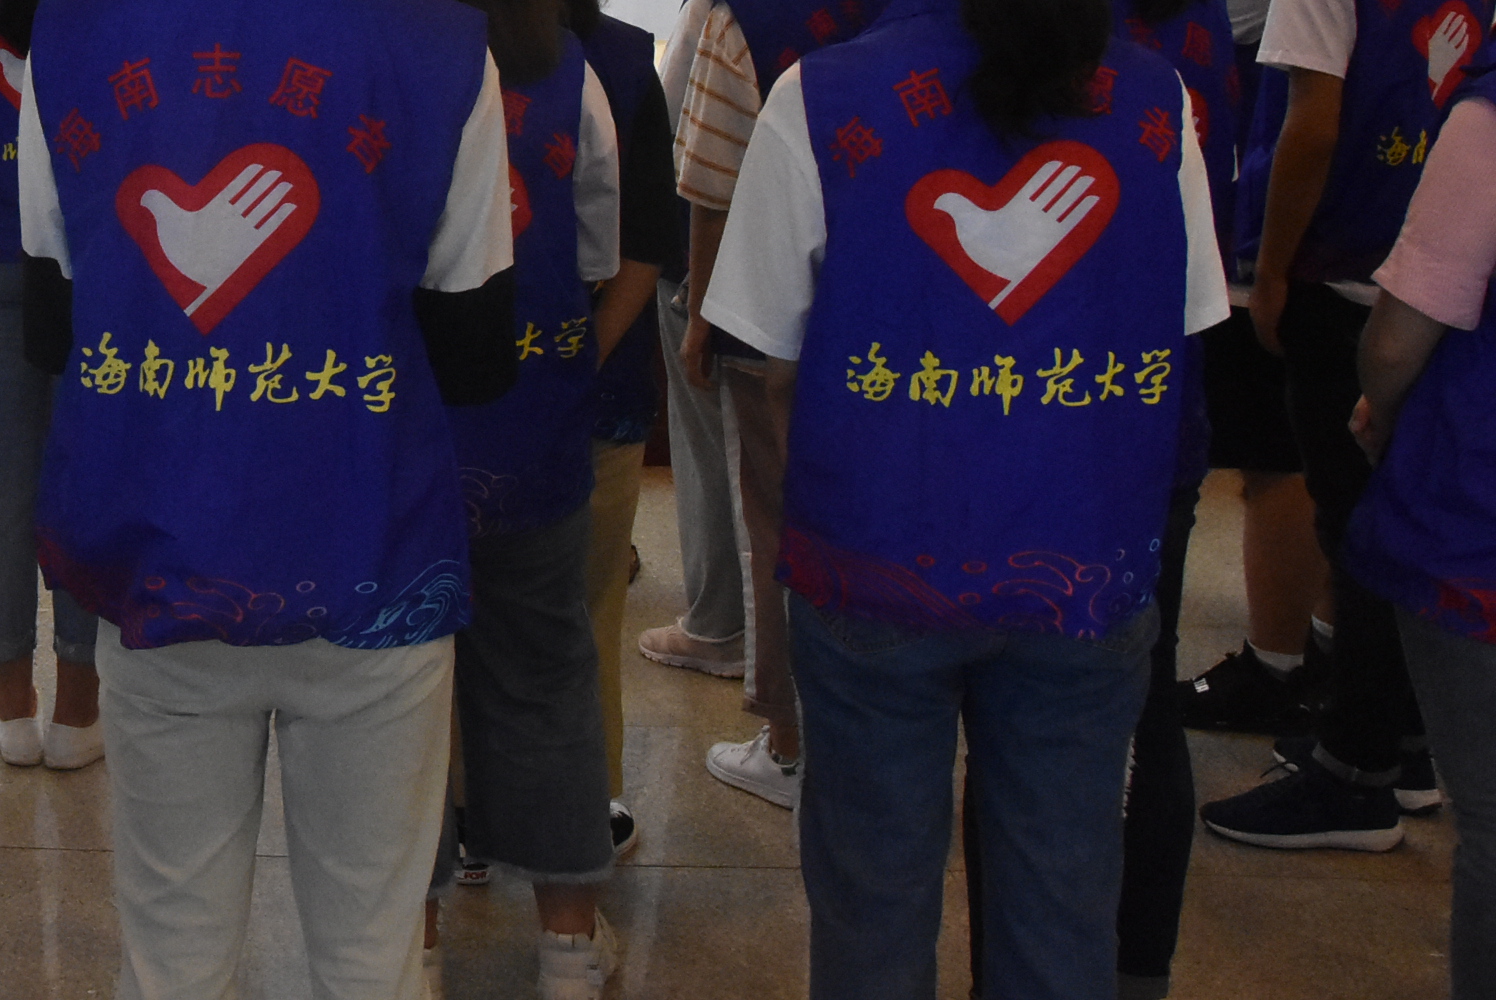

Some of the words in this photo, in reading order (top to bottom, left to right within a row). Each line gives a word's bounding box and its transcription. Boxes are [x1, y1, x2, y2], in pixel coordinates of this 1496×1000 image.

[54, 43, 391, 174] 海南志愿者
[80, 331, 396, 413] 海南师范大学
[846, 342, 1171, 415] 海南师范大学
